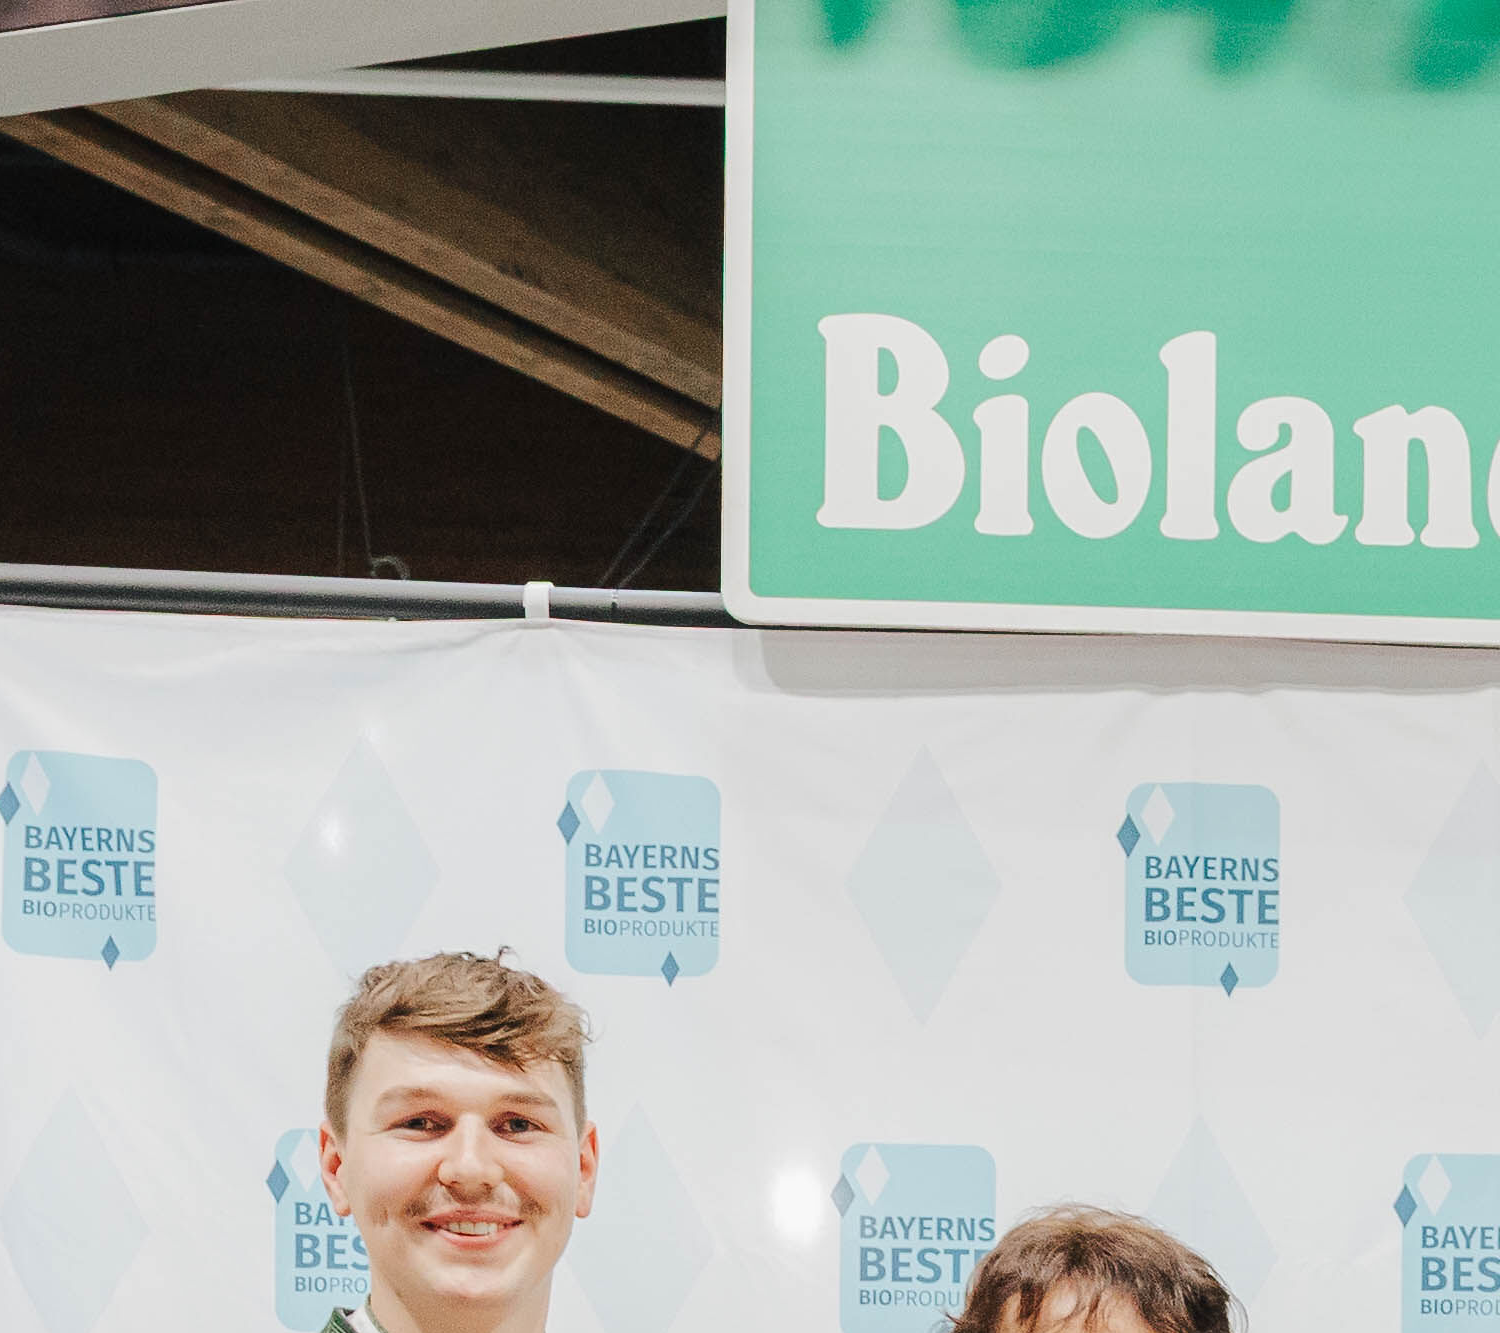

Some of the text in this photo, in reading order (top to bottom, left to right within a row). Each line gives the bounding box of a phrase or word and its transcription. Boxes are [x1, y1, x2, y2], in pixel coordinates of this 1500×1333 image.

[25, 826, 155, 853] BAYERNS
[585, 844, 720, 870] BAYERNS
[1145, 856, 1279, 882] BAYERNS
[24, 857, 155, 897] BESTE
[584, 875, 720, 913] BESTE
[1145, 887, 1279, 924] BESTE
[23, 899, 156, 921] BIOPRODUKTE
[584, 918, 720, 937] BIOPRODUKTE
[1144, 929, 1279, 949] BIOPRODUKTE
[860, 1216, 995, 1241] BAYERNS
[295, 1233, 369, 1270] BES
[860, 1246, 994, 1284] BEST
[295, 1276, 368, 1294] BIOPRO
[860, 1289, 960, 1308] BIOPRODU
